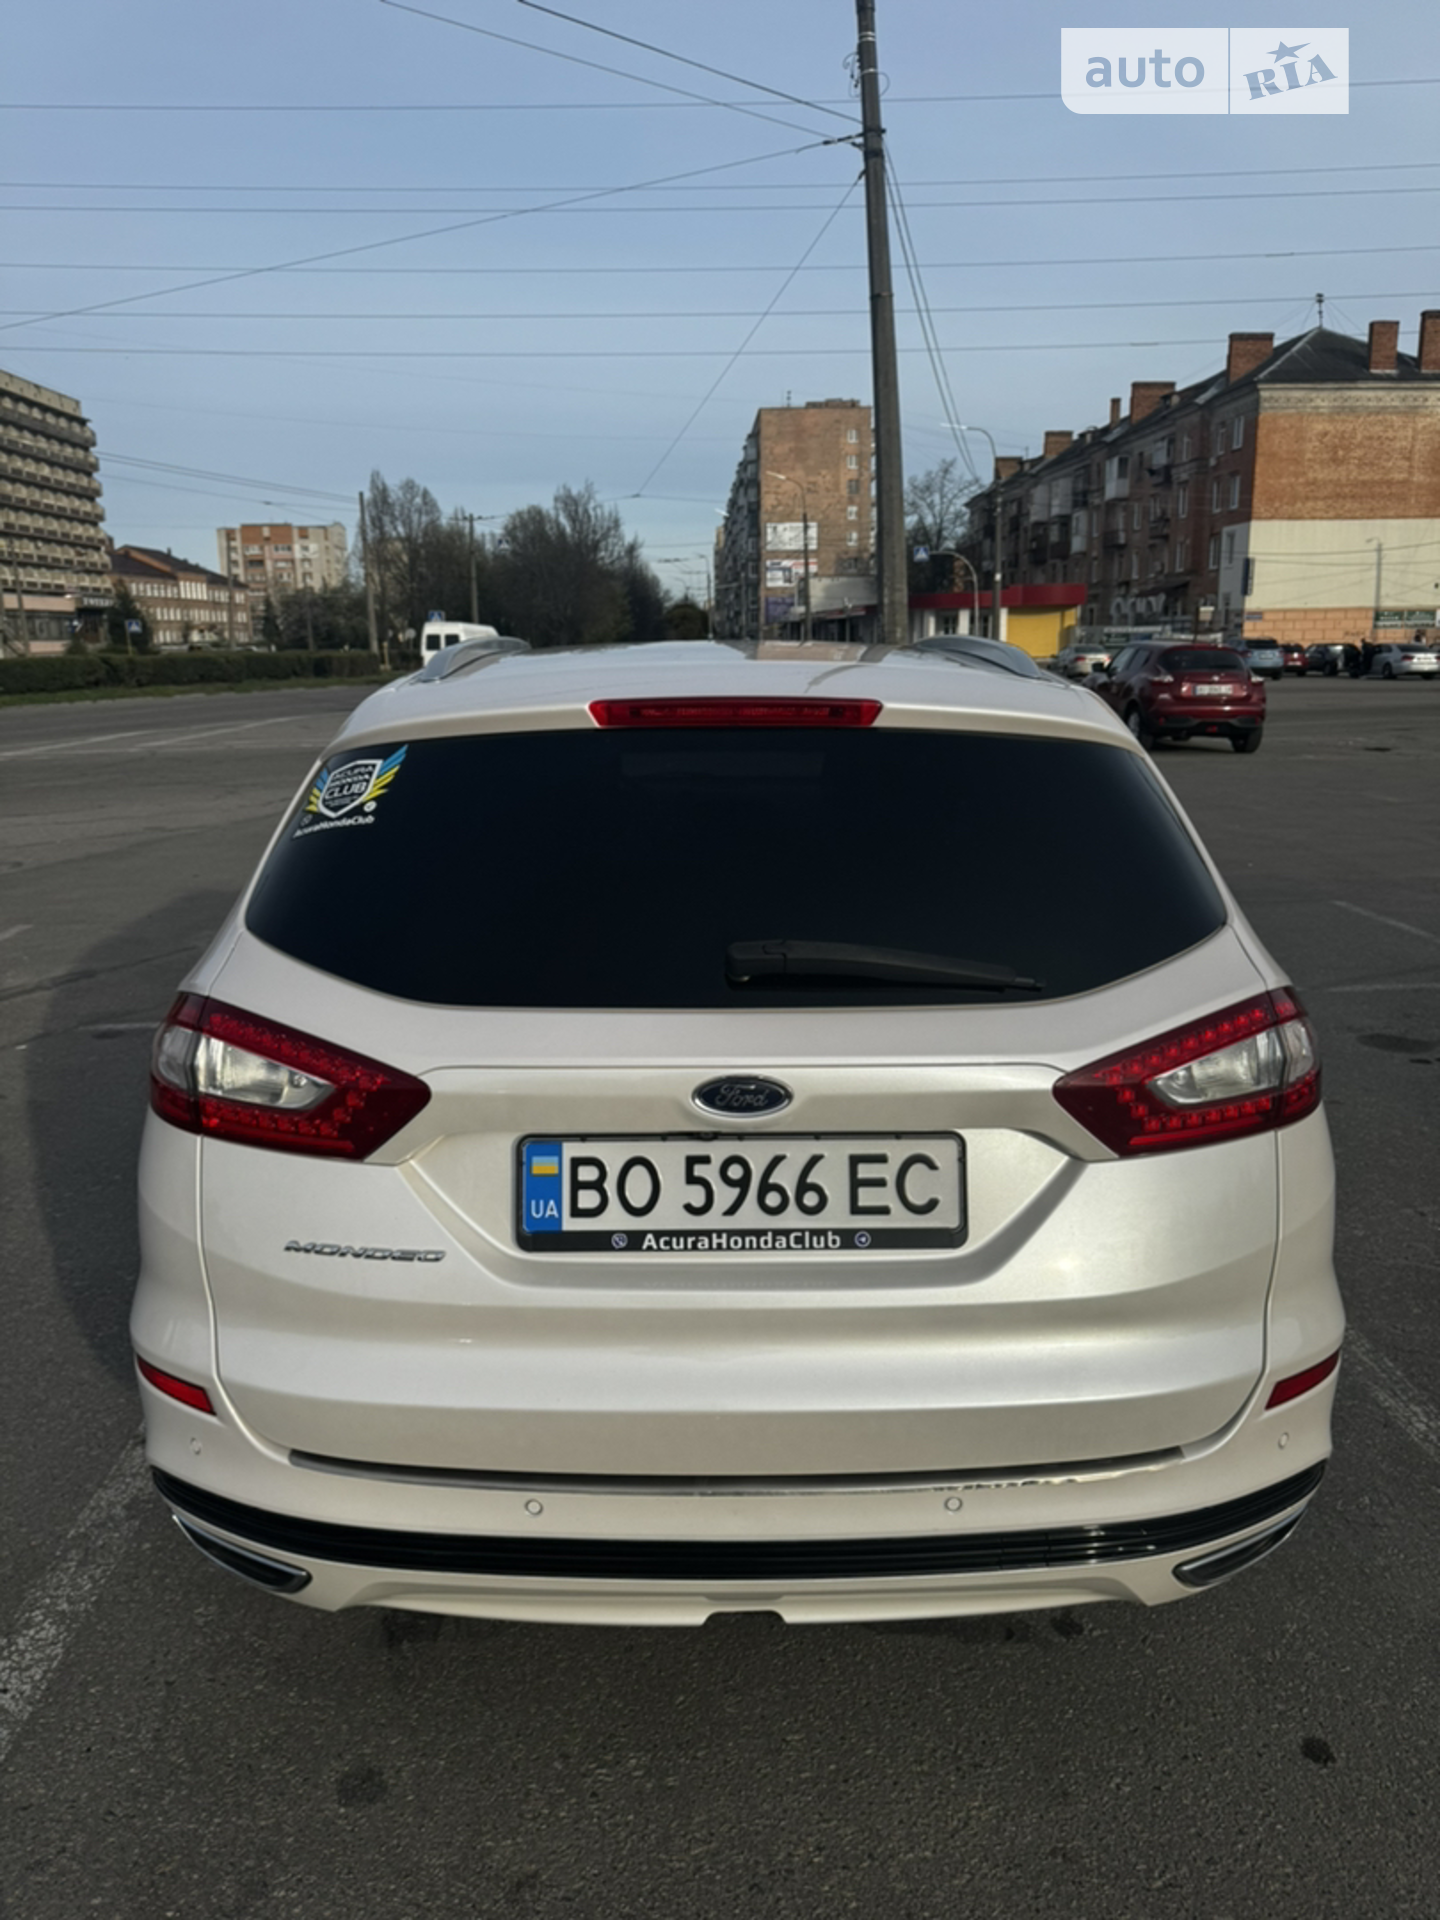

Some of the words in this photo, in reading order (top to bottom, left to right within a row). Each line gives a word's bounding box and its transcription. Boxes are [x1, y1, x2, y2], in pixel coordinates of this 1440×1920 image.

[324, 782, 367, 799] CLUB
[715, 1084, 769, 1107] Ford
[570, 1155, 662, 1218] BO
[682, 1153, 829, 1217] 5966
[849, 1152, 941, 1216] EC
[530, 1200, 559, 1219] UA
[284, 1240, 447, 1263] MONDEO
[641, 1231, 842, 1251] AcuraHondaClub
